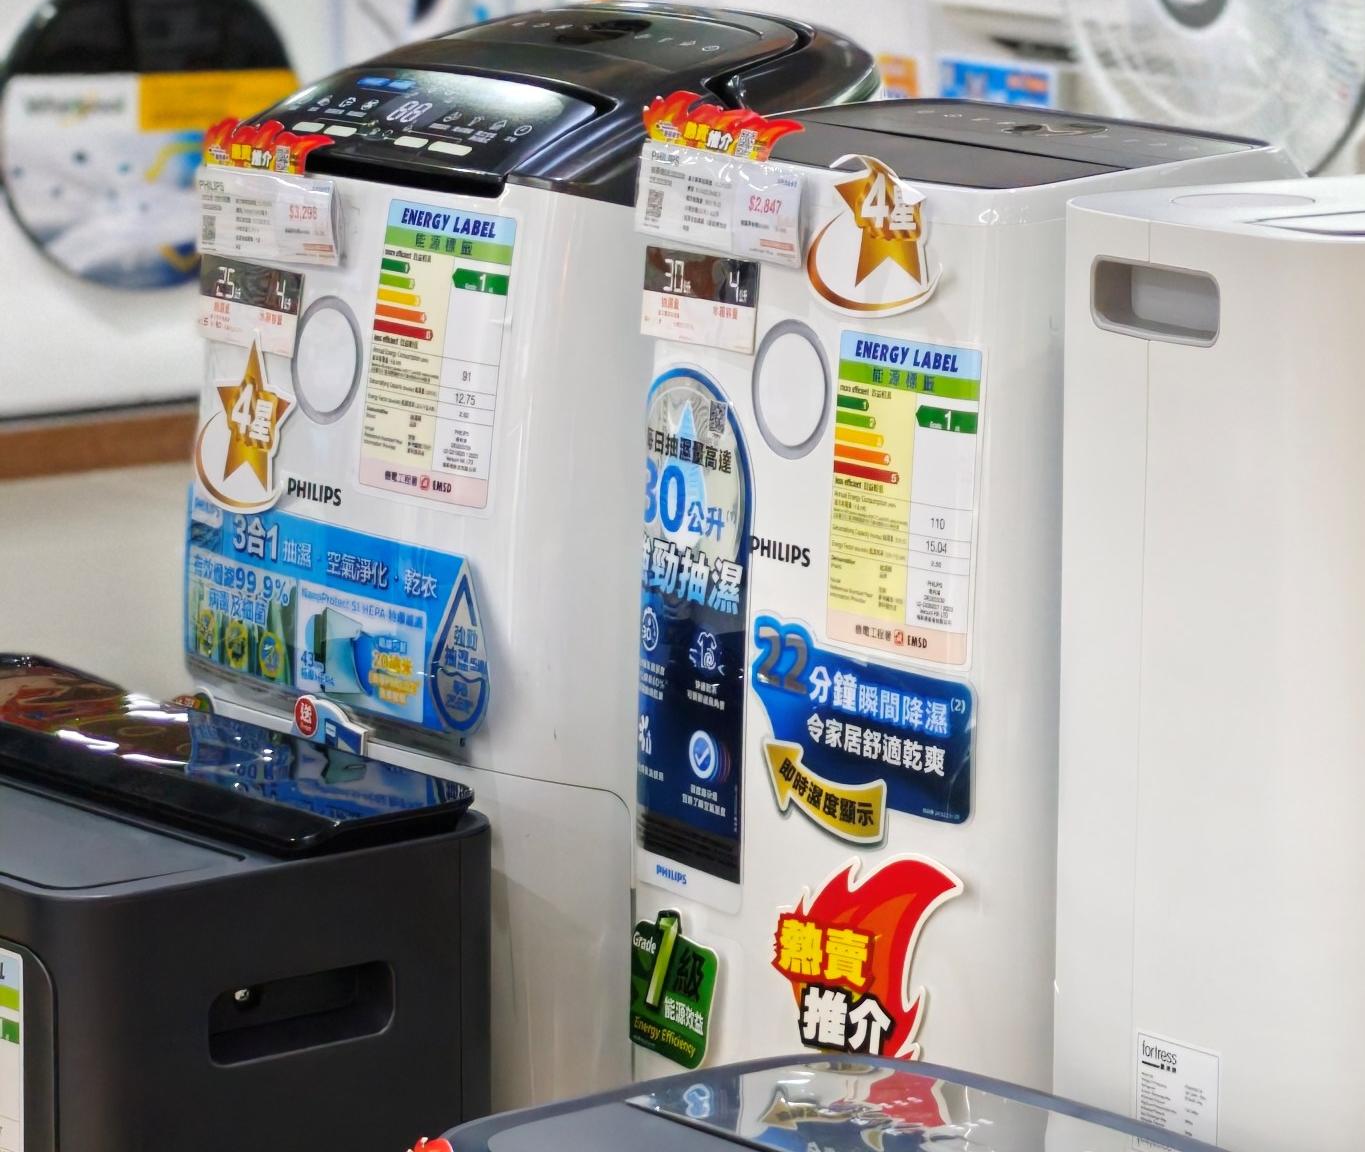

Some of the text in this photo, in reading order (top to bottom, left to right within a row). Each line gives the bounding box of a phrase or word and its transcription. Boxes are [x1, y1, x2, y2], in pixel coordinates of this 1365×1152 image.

[400, 207, 497, 239] ENERGY LABEL
[749, 195, 782, 217] $2,847
[479, 273, 486, 291] 1
[855, 339, 959, 373] ENERGY LABEL
[231, 377, 274, 444] 4星
[455, 392, 476, 406] 12.75
[944, 410, 952, 431] 1
[288, 477, 342, 507] PHILIPS
[432, 480, 452, 493] EMSD
[930, 517, 946, 530] 110
[232, 516, 438, 599] 3合1 抽濕 空氣淨化 乾衣
[749, 534, 811, 568] PHILIPS
[644, 535, 744, 615] 勁抽濕
[907, 636, 928, 649] EMSD
[757, 626, 808, 694] 22
[808, 665, 948, 735] 分鐘瞬間降濕
[950, 698, 966, 713] (2)
[806, 713, 946, 777] 令家居舒適乾爽
[779, 758, 875, 827] 即時濕度顯示
[656, 864, 688, 885] PHILIPS
[633, 931, 657, 955] Grade
[646, 916, 679, 1008] 1
[778, 918, 870, 987] 熱賣
[664, 995, 704, 1036] 能源效益
[802, 986, 892, 1056] 推介
[634, 1016, 696, 1059] Energy Efficiency
[1142, 1040, 1177, 1066] fortress
